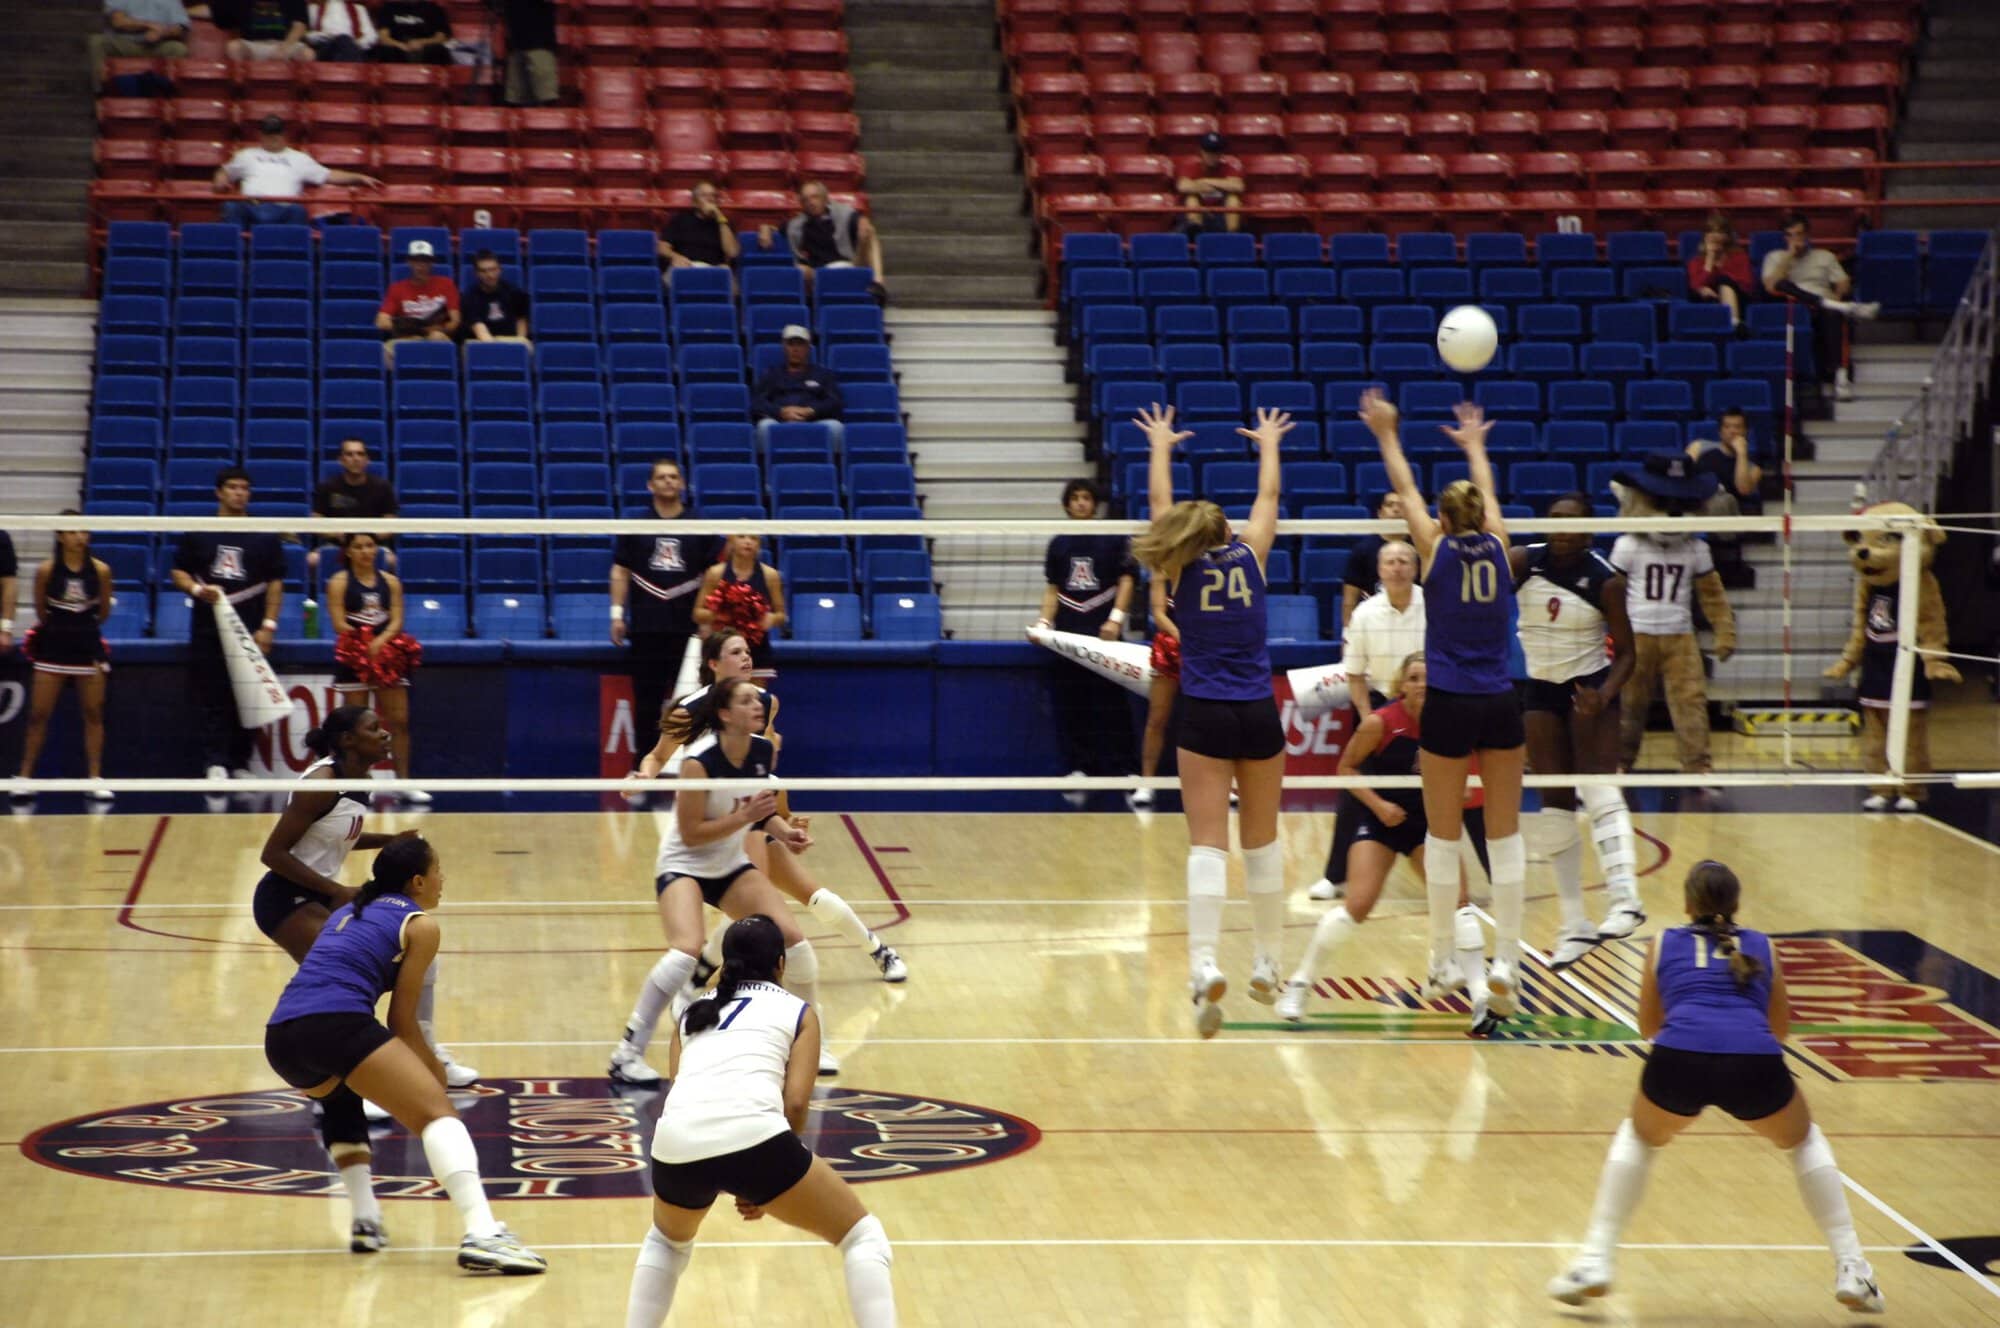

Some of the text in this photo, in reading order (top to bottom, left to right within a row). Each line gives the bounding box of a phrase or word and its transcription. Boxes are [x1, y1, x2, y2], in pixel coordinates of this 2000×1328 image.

[1201, 566, 1252, 611] 24
[1461, 559, 1496, 603] 10
[1645, 563, 1684, 602] 07
[1547, 597, 1561, 622] 9
[717, 996, 752, 1031] 7
